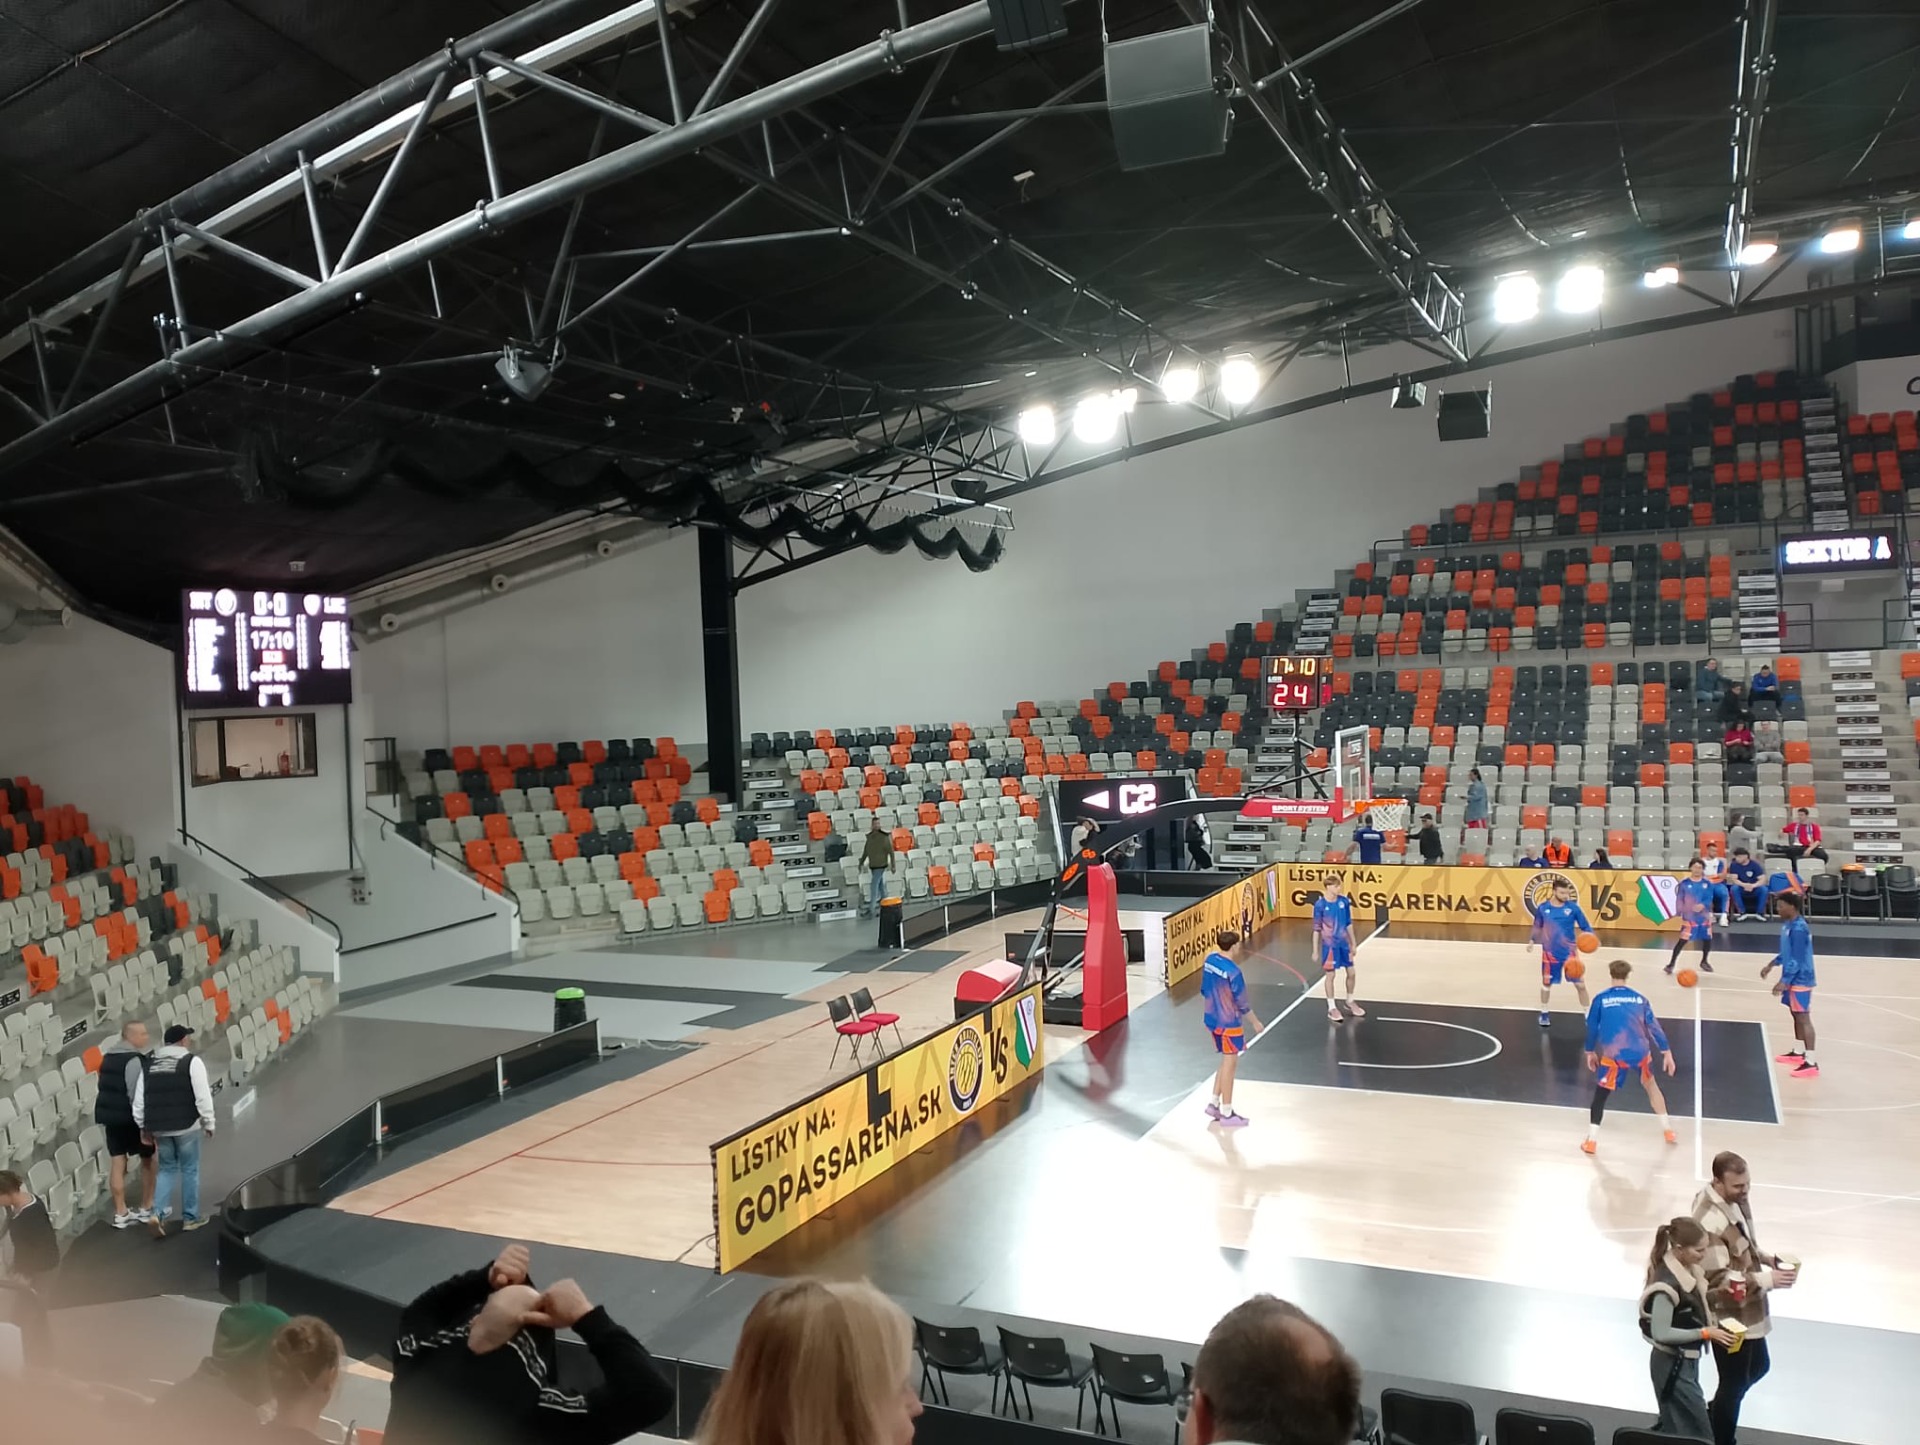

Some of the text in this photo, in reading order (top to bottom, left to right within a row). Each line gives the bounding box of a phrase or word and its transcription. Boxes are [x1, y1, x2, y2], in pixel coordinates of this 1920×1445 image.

[1875, 536, 1892, 560] A
[1119, 784, 1156, 814] C2
[1353, 870, 1382, 884] NA:
[1590, 883, 1624, 921] VS
[990, 1026, 1009, 1084] VS
[731, 1107, 836, 1182] LÍSTKY NA:
[735, 1085, 942, 1236] GOPASSARENA.SK
